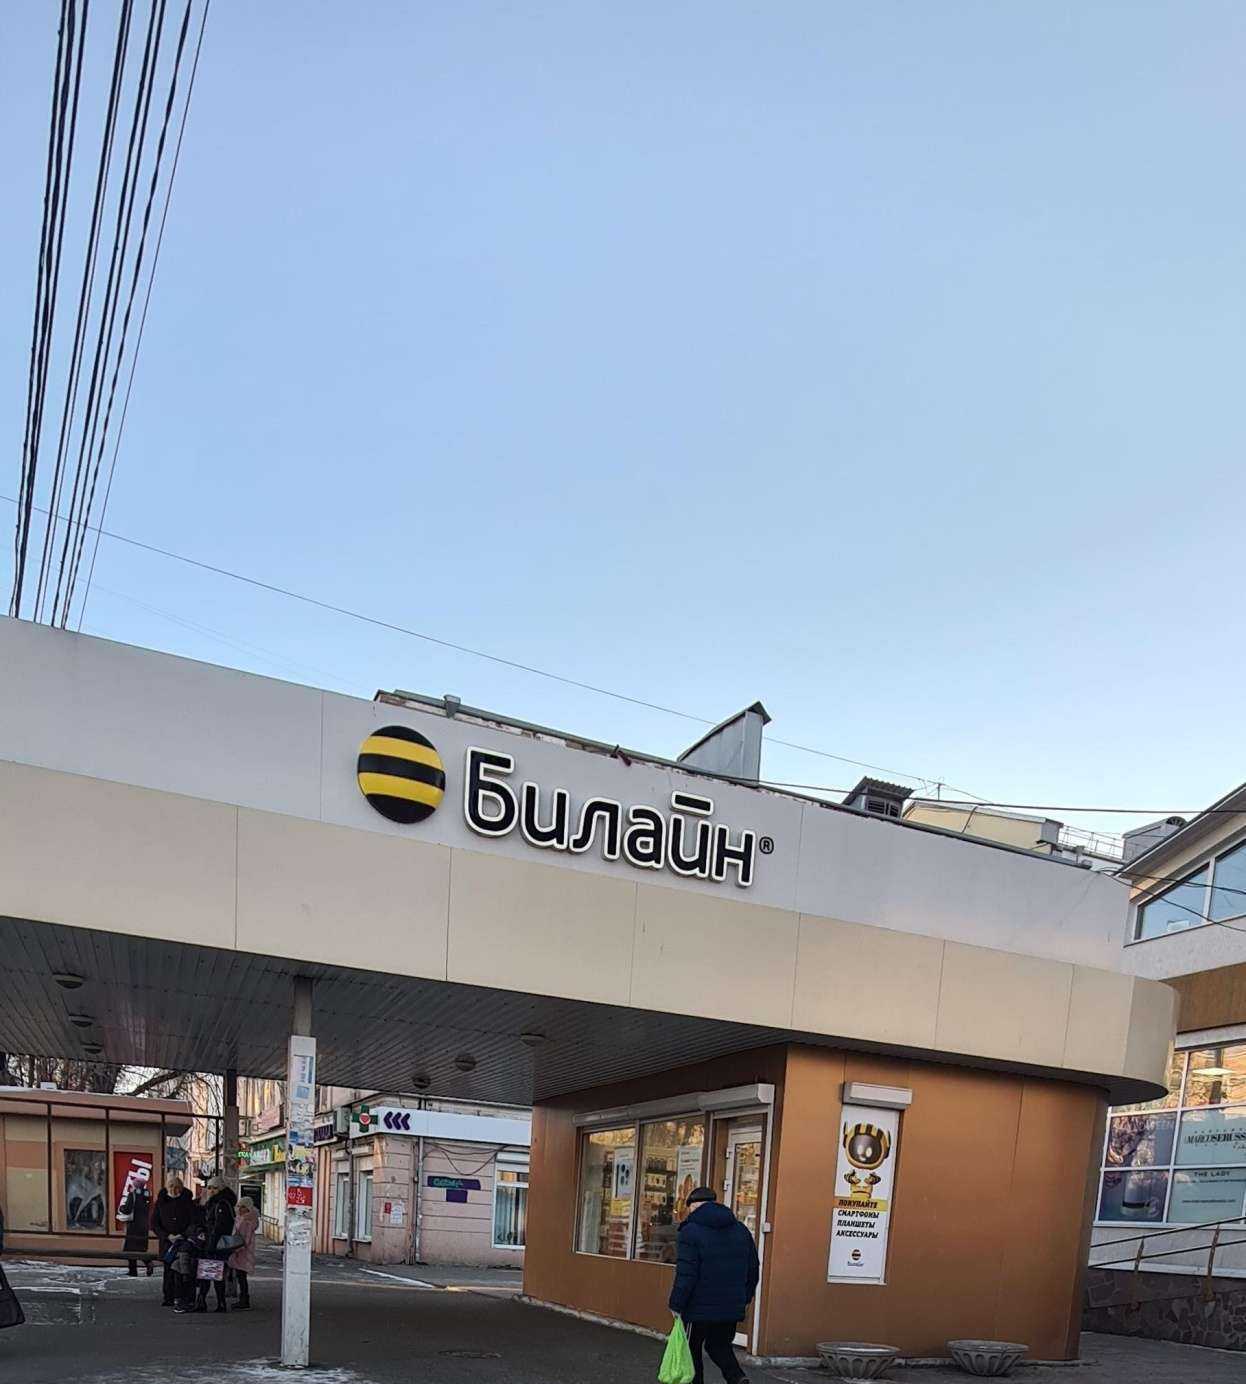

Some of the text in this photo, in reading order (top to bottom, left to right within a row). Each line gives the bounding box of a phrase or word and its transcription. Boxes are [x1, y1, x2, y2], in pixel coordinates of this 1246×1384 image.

[838, 1199, 878, 1209] ПОКУПАЙТЕ
[837, 1209, 879, 1219] СМАРТФОНЫ
[836, 1219, 875, 1229] ПЛАНШЕТЫ
[836, 1229, 879, 1239] АКСЕССУАРЫ
